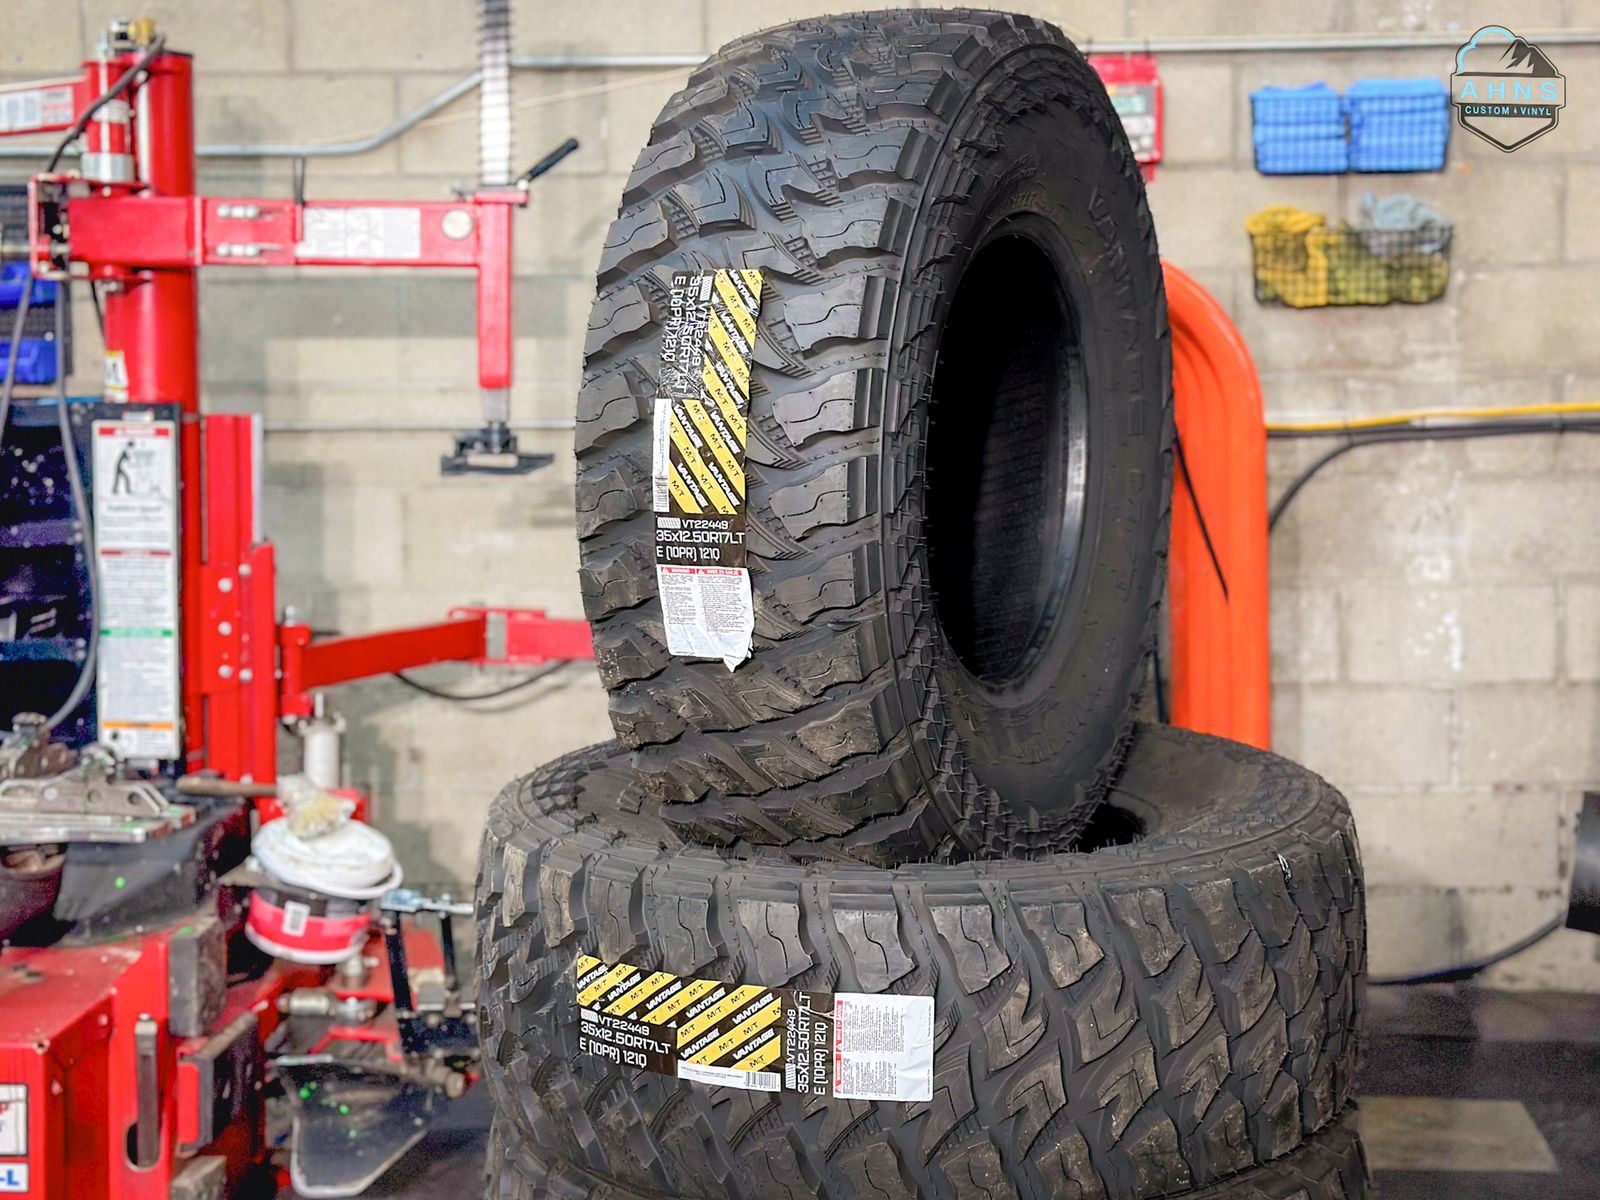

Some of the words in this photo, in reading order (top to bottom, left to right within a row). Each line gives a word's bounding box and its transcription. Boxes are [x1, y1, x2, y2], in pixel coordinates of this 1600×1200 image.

[675, 276, 686, 285] E
[743, 318, 755, 334] M/T
[723, 341, 735, 357] M/T
[736, 368, 749, 383] M/T
[715, 388, 728, 405] M/T
[729, 414, 743, 430] M/T
[674, 404, 703, 448] VANTAGE
[710, 410, 740, 454] VANTAGE
[684, 446, 696, 463] M/T
[700, 473, 713, 490] M/T
[710, 433, 722, 449] M/T
[726, 460, 739, 477] M/T
[672, 480, 684, 497] M/T
[677, 462, 709, 508] VANTAGE
[708, 461, 740, 506] VANTAGE
[682, 519, 729, 530] VT22449
[656, 546, 664, 557] E
[699, 547, 720, 561] 121Q
[577, 964, 608, 990] VANTAGE
[594, 979, 607, 992] M/T
[616, 965, 627, 978] M/T
[607, 972, 641, 1001] VANTAGE
[630, 988, 644, 1001] M/T
[651, 974, 665, 987] M/T
[645, 980, 682, 1010] VANTAGE
[667, 999, 681, 1012] M/T
[689, 983, 704, 997] M/T
[686, 987, 726, 1018] VANTAGE
[732, 992, 774, 1024] VANTAGE
[598, 1015, 650, 1036] VT22449
[680, 1024, 695, 1037] M/T
[706, 1006, 722, 1020] M/T
[731, 990, 746, 1004] M/T
[680, 1028, 720, 1059] VANTAGE
[719, 1038, 734, 1051] M/T
[743, 1022, 758, 1035] M/T
[733, 1028, 775, 1060] VANTAGE
[815, 1022, 828, 1045] 121Q
[580, 1037, 587, 1050] E
[623, 1050, 647, 1068] 121Q
[749, 1055, 764, 1068] M/T
[814, 1087, 825, 1095] E
